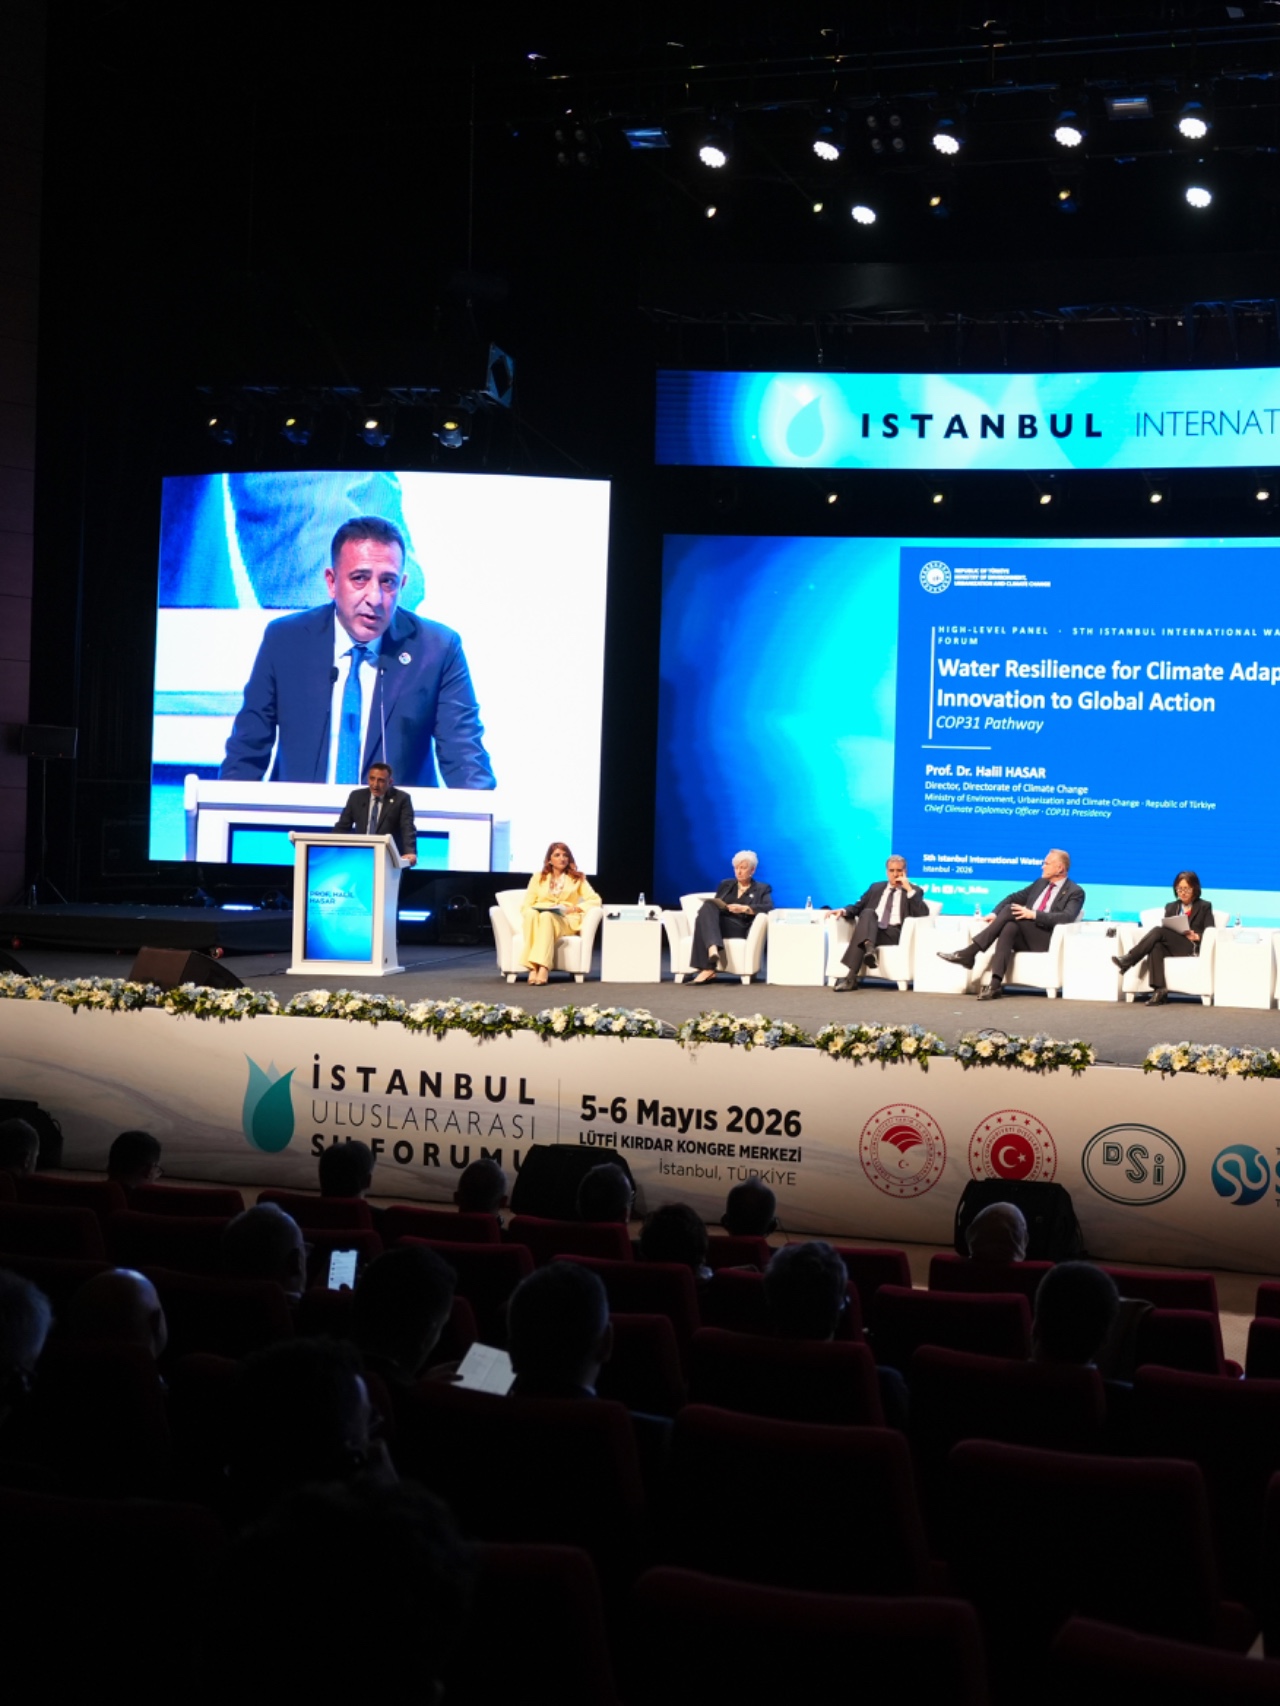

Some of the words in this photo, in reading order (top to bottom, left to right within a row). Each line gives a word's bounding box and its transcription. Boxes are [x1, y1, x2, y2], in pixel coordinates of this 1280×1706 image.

[861, 412, 1102, 439] ISTANBUL
[938, 625, 1006, 634] HIGH-LEVEL
[1012, 627, 1048, 635] PANEL
[1100, 628, 1156, 636] ISTANBUL
[1162, 628, 1257, 636] INTERNATIONAL
[938, 637, 979, 645] FORUM
[937, 658, 1000, 677] Water
[1005, 659, 1106, 679] Resilience
[1112, 660, 1141, 680] for
[1146, 660, 1224, 680] Climate
[937, 688, 1046, 709] Innovation
[1051, 691, 1073, 709] to
[1078, 690, 1144, 710] Global
[1149, 692, 1216, 712] Action
[936, 715, 980, 730] COP31
[984, 716, 1044, 733] Pathway
[925, 764, 953, 776] Prof.
[956, 765, 973, 776] Dr.
[1005, 766, 1046, 779] HASAR
[925, 781, 960, 791] Director,
[963, 782, 1010, 791] Directorate
[1012, 783, 1022, 792] of
[1023, 783, 1054, 793] Climate
[1057, 785, 1089, 796] Change
[925, 793, 955, 803] Ministry
[957, 793, 965, 802] of
[1066, 797, 1080, 805] and
[1082, 797, 1110, 806] Climate
[1112, 798, 1140, 808] Change
[1145, 799, 1178, 809] Republic
[1179, 800, 1188, 808] of
[938, 854, 968, 863] Istanbul
[969, 855, 1018, 865] International
[1020, 857, 1043, 865] Water
[312, 1053, 535, 1105] İSTANBUL
[312, 1099, 535, 1139] ULUSLARARASI
[580, 1094, 627, 1124] 5-6
[637, 1099, 718, 1134] Mayıs
[726, 1105, 802, 1138] 2026
[310, 1133, 352, 1158] S
[579, 1129, 617, 1147] LÜTFİ
[620, 1135, 673, 1152] KIRDAR
[677, 1140, 735, 1157] KONGRE
[739, 1145, 802, 1163] MERKEZİ
[658, 1158, 722, 1181] İstanbul,
